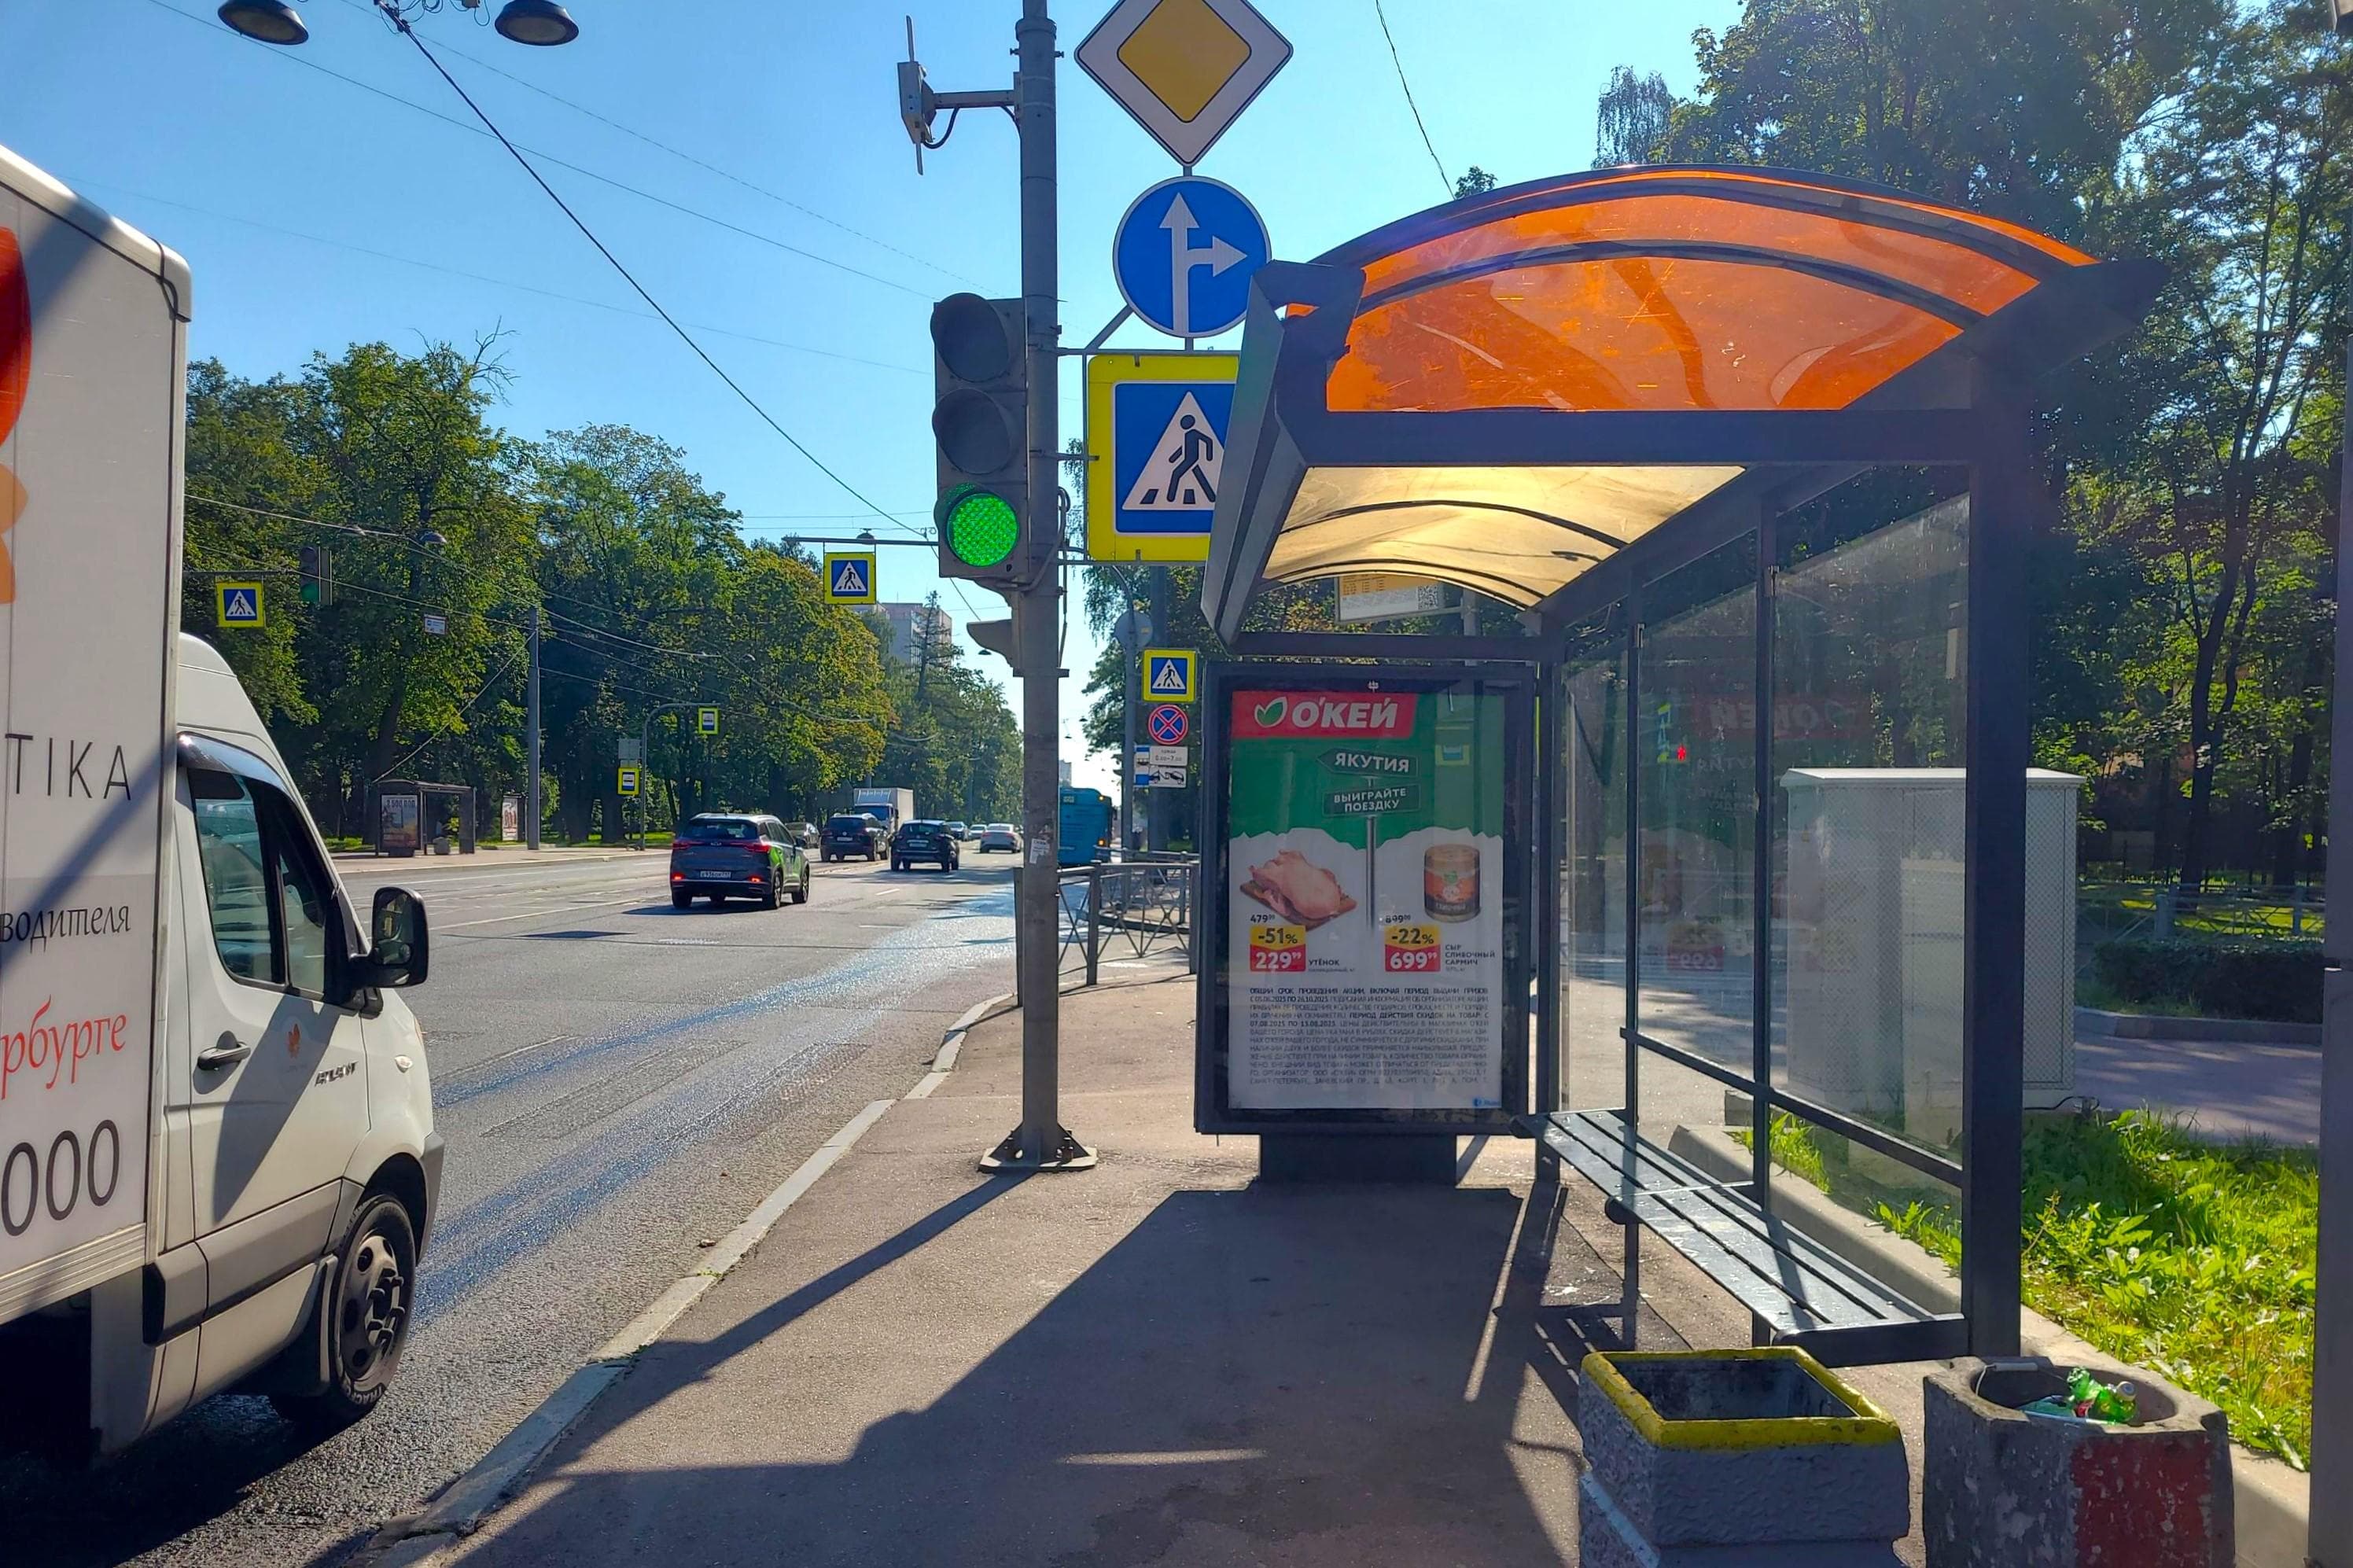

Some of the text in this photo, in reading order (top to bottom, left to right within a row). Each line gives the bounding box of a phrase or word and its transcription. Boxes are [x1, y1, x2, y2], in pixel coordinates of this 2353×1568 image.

[1335, 753, 1409, 773] ЯКУТИЯ
[1334, 788, 1406, 804] ВЫИГРАЙТЕ
[1345, 800, 1400, 812] ПОЕЗДКУ
[0, 906, 131, 954] водителя
[1258, 927, 1298, 944] -51%
[1391, 928, 1434, 944] -22%
[1308, 958, 1340, 966] УТЁНОК
[1445, 950, 1496, 959] СЛИВОЧНЫЙ
[0, 993, 127, 1100] рбурге
[0, 1120, 120, 1237] 000
